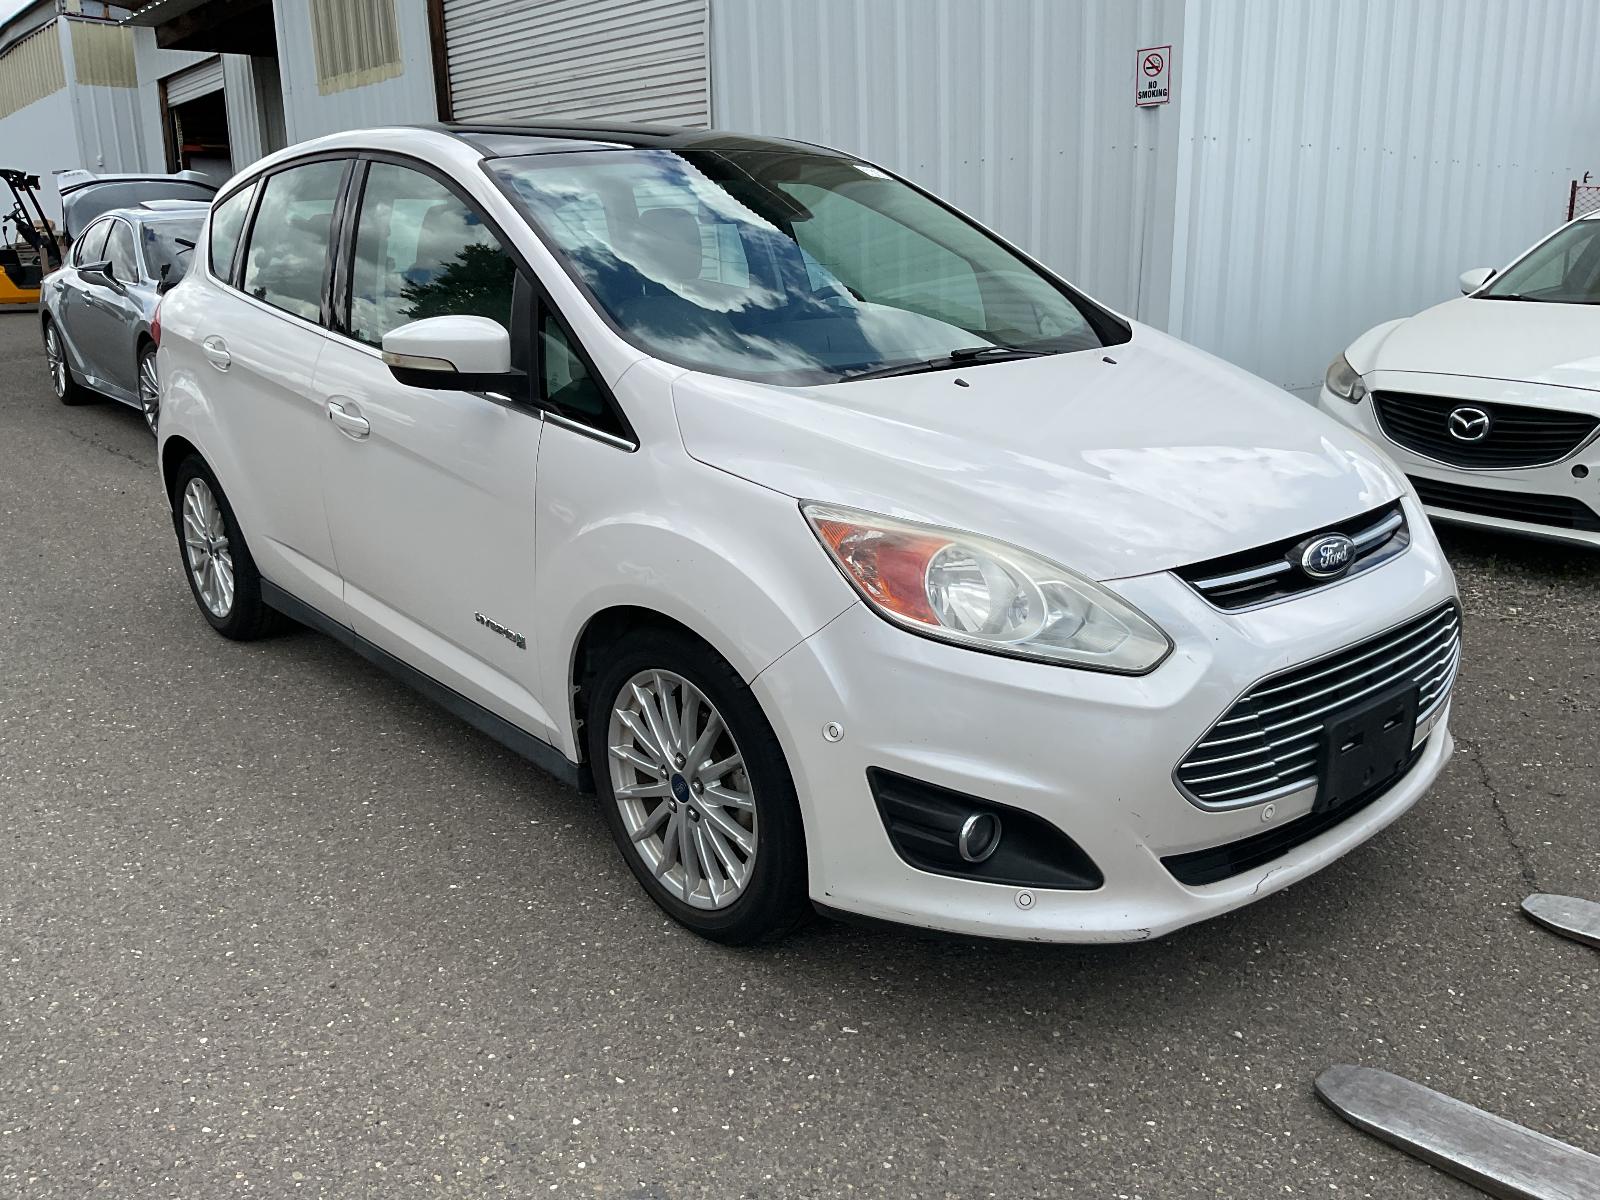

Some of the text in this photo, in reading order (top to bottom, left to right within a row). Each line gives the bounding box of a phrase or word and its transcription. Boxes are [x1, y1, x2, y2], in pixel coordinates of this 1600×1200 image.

[1148, 81, 1157, 89] NO
[1138, 88, 1167, 99] SMOKING
[1320, 542, 1348, 569] Ford
